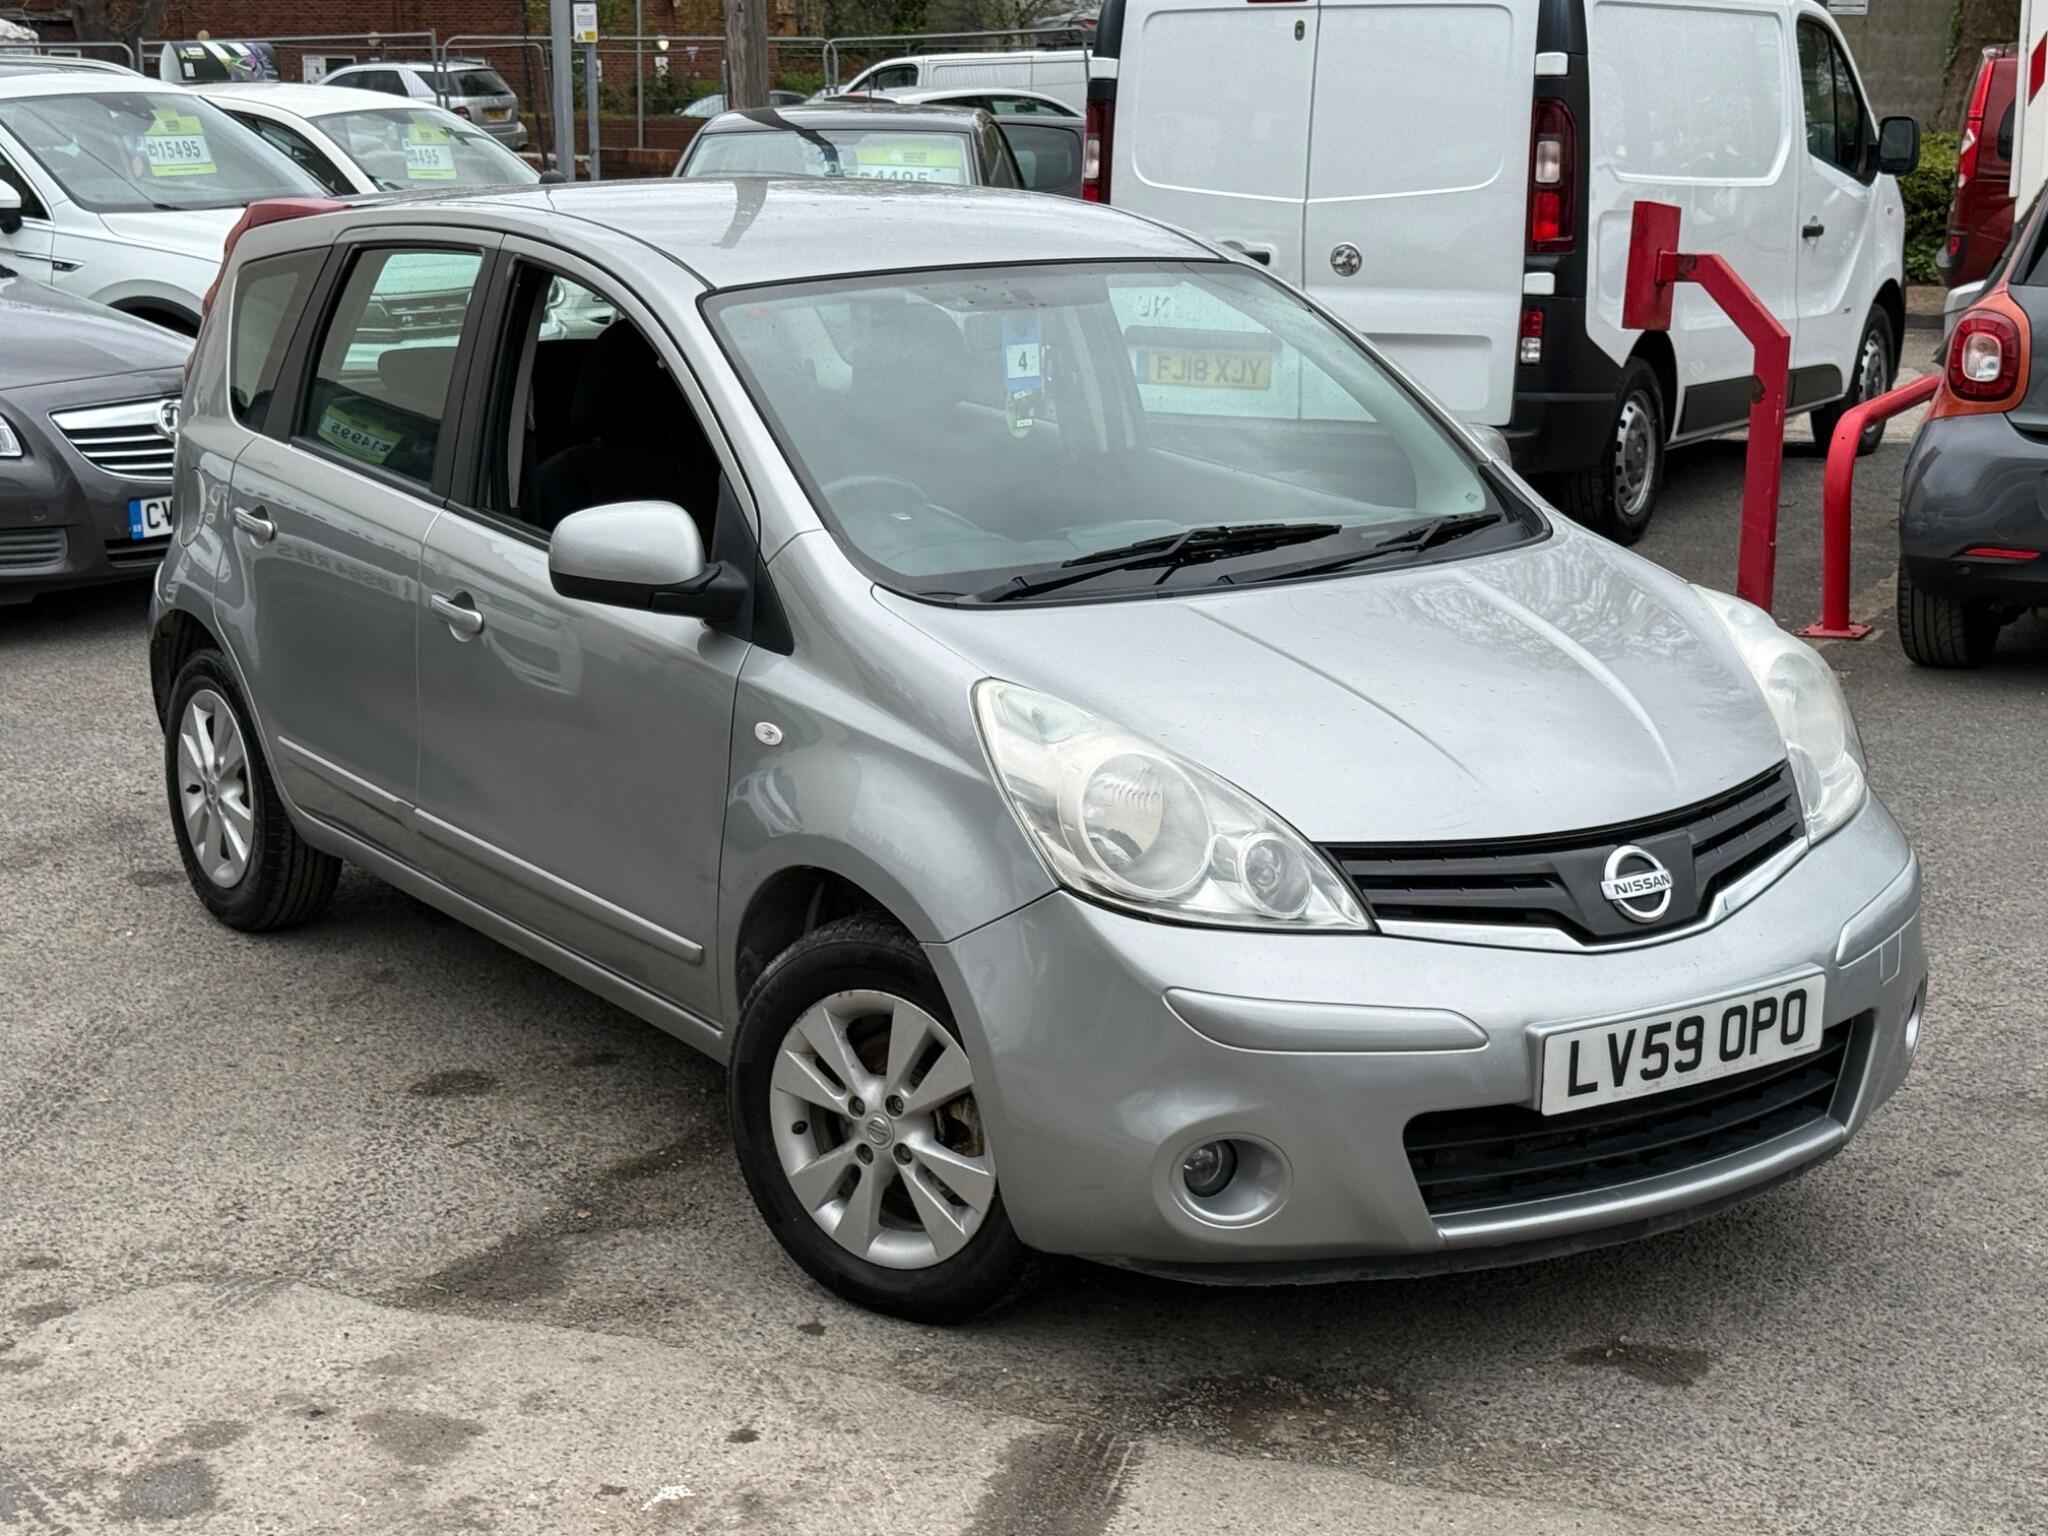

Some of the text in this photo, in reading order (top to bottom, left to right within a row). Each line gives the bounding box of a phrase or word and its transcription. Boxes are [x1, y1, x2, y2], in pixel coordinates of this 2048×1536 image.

[1018, 351, 1028, 371] 4
[1157, 356, 1262, 385] FJ18 XJY
[1613, 873, 1671, 895] NISSAN
[1567, 988, 1807, 1098] LV59 OPO
